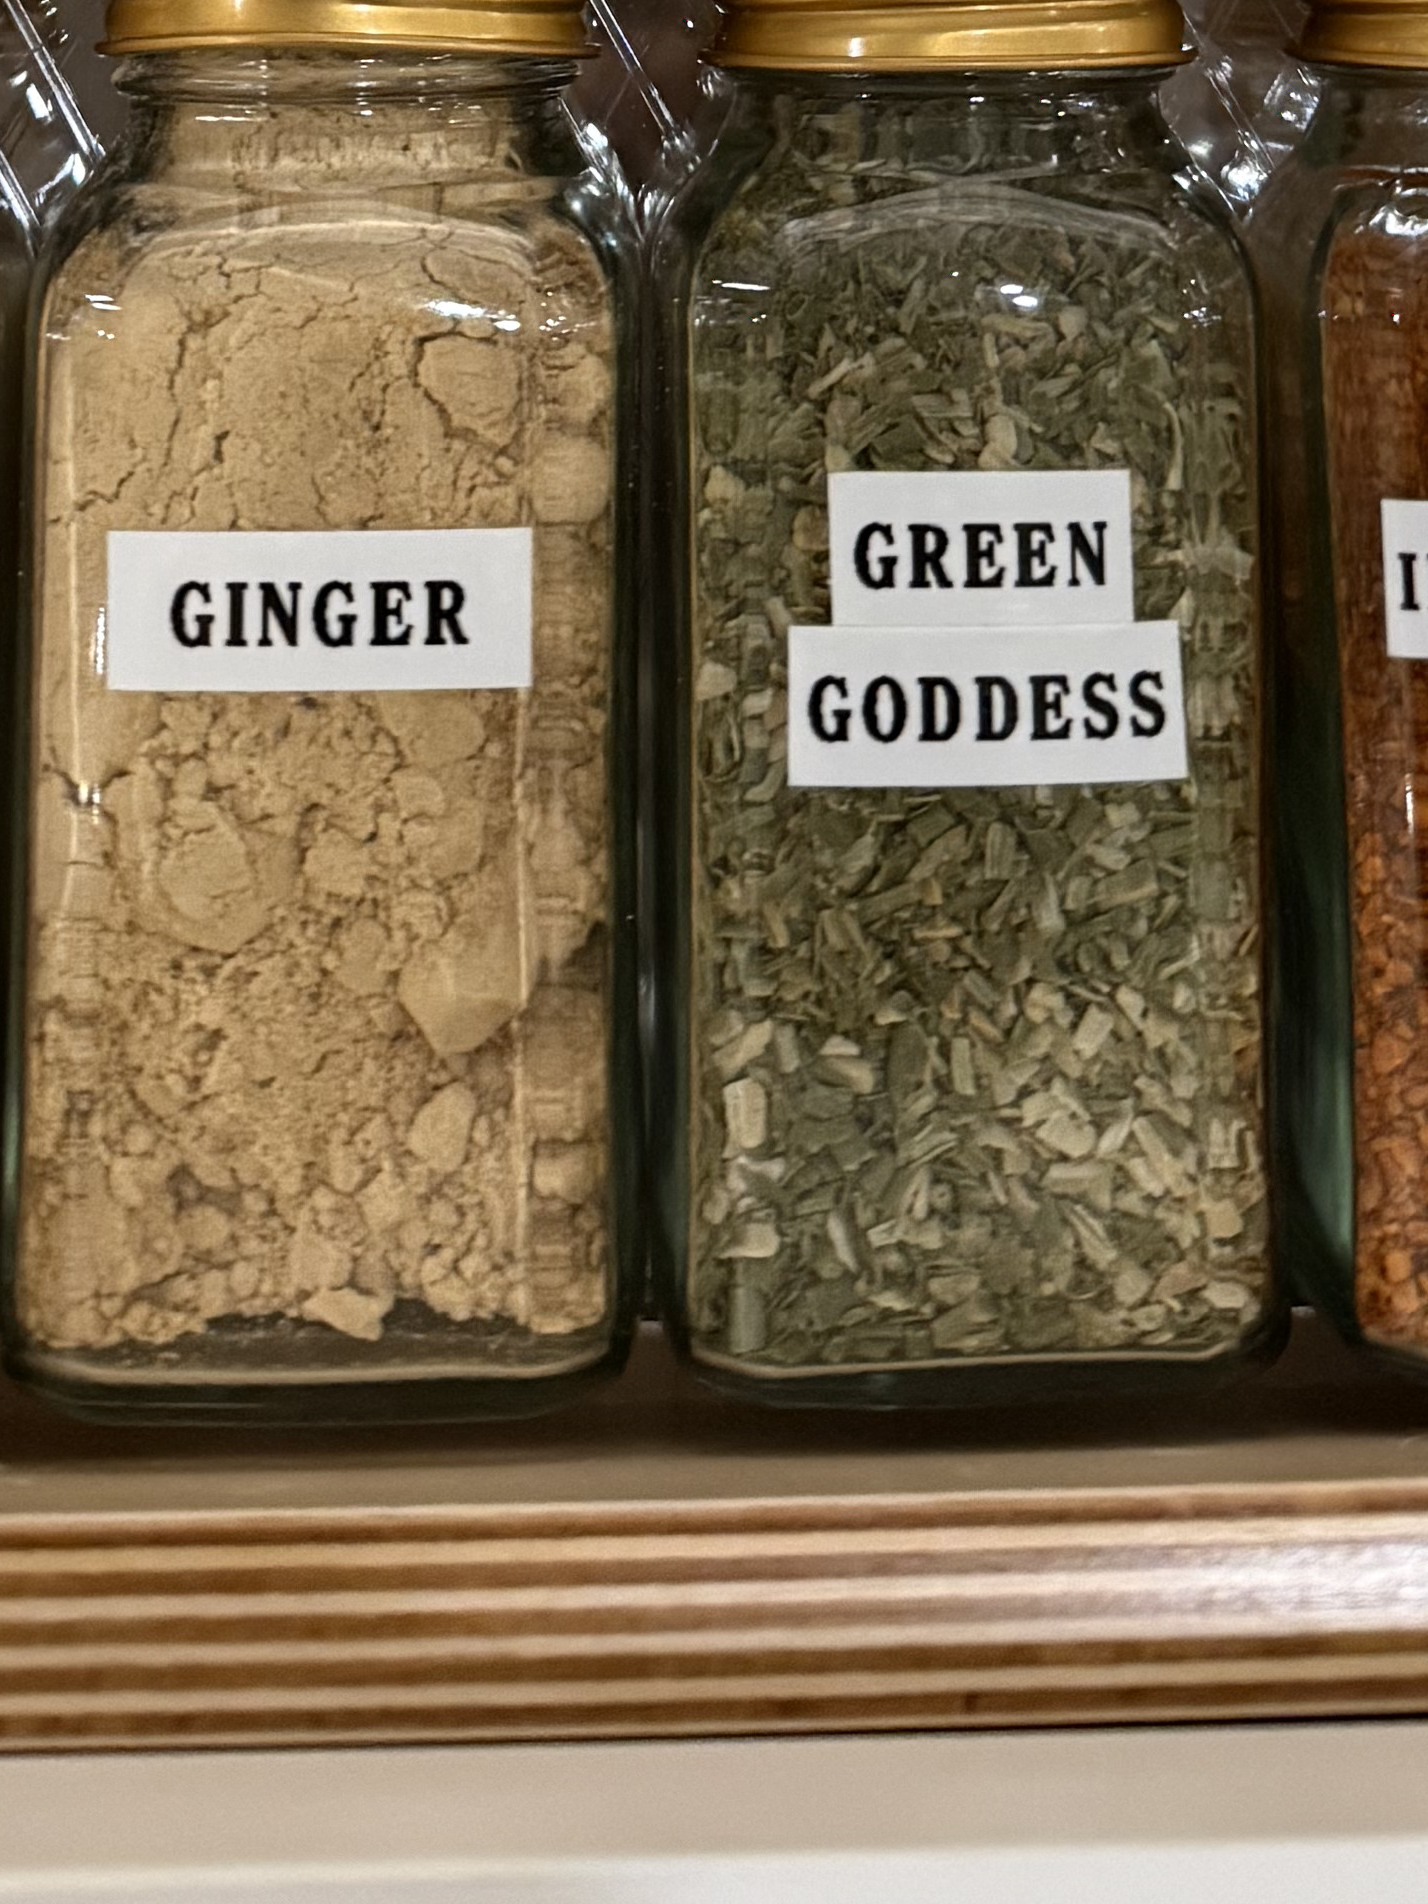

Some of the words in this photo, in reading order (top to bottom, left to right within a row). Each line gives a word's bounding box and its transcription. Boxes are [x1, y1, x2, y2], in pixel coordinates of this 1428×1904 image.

[853, 521, 1107, 590] GREEN
[170, 580, 469, 648] GINGER
[807, 670, 1166, 744] GODDESS
